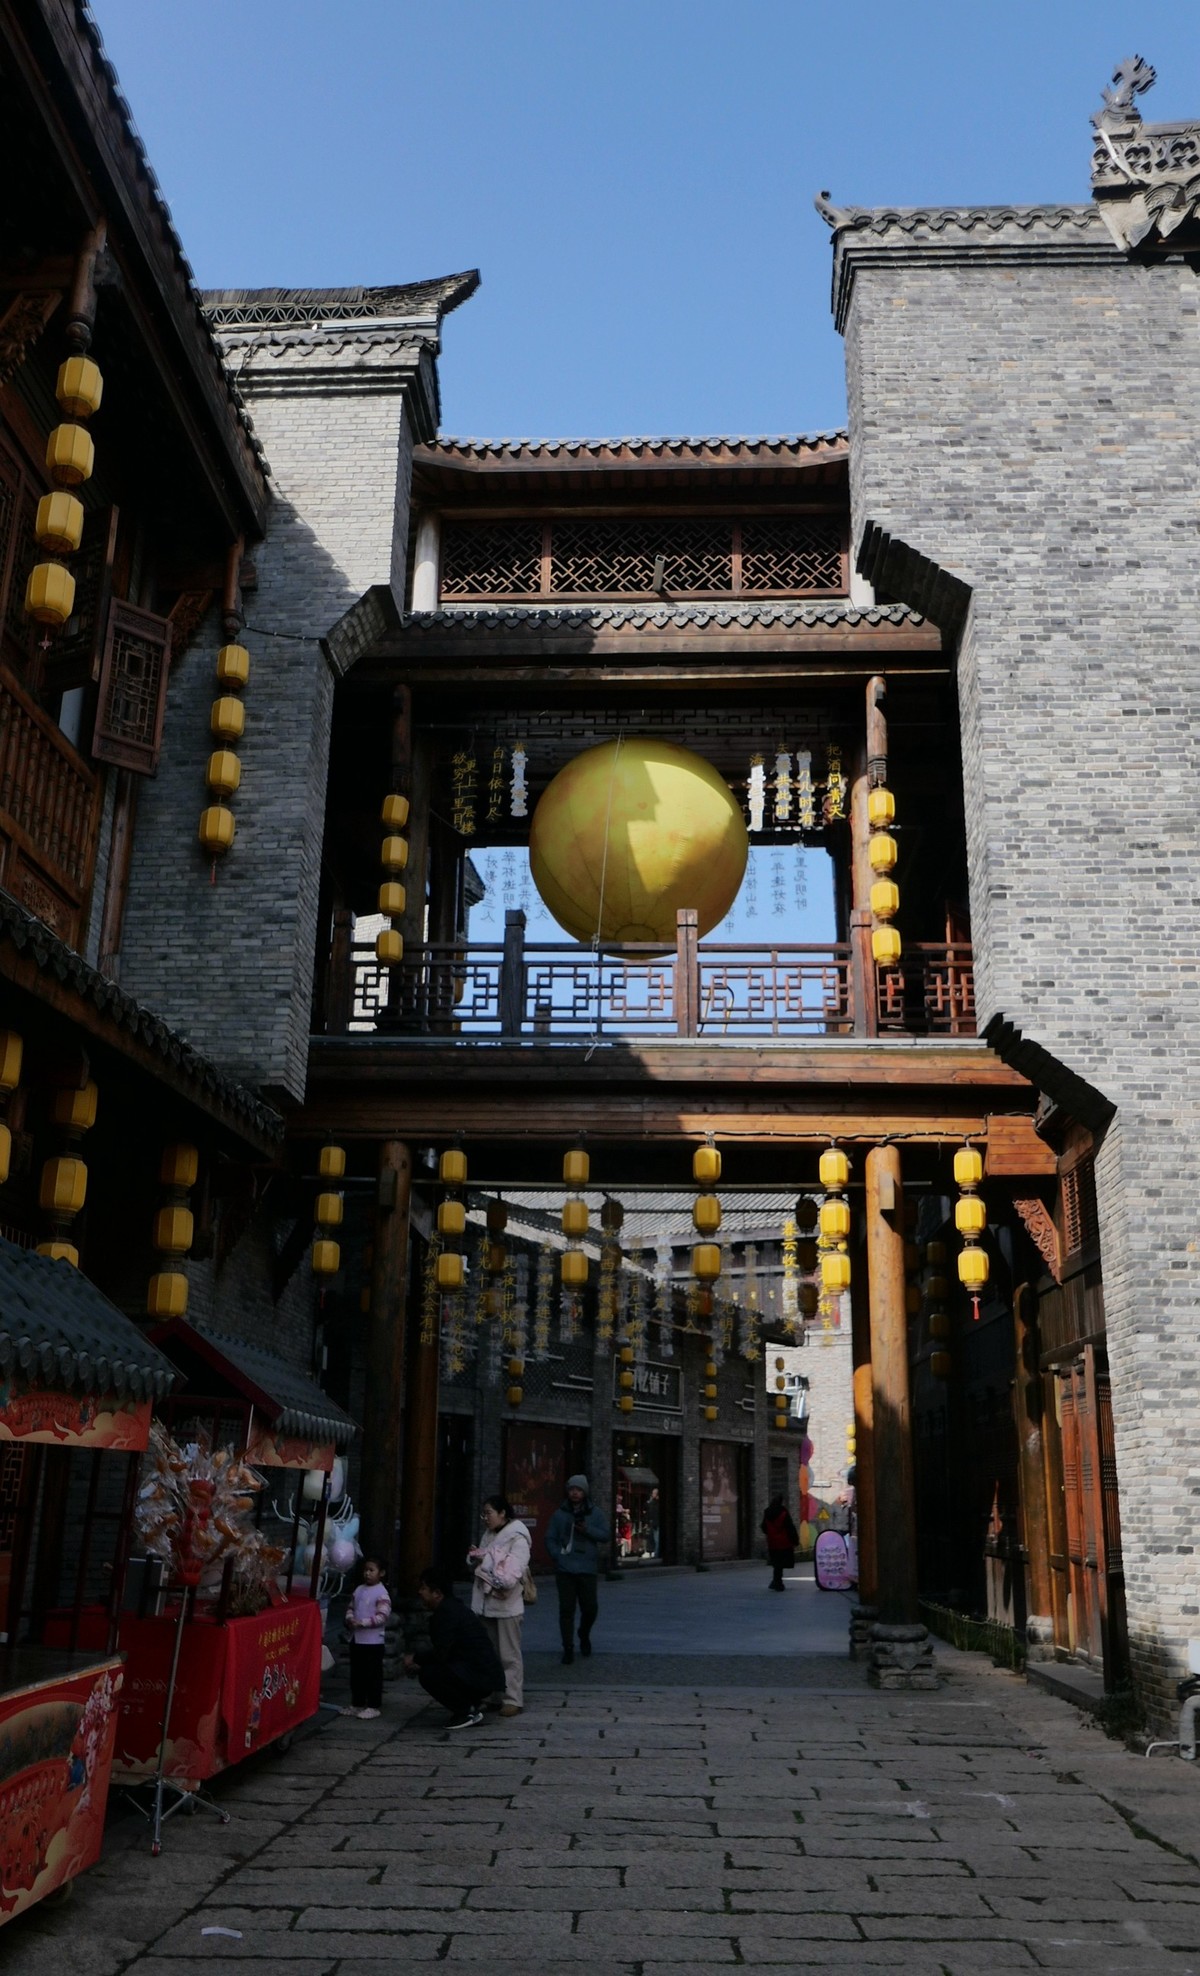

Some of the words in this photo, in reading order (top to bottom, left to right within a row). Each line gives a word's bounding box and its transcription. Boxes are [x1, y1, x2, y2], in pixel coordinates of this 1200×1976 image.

[485, 746, 505, 822] 白日依山尽
[796, 750, 816, 828] 明月几时有
[826, 743, 846, 819] 把酒问青天
[499, 1256, 518, 1343] 此夜中秋月
